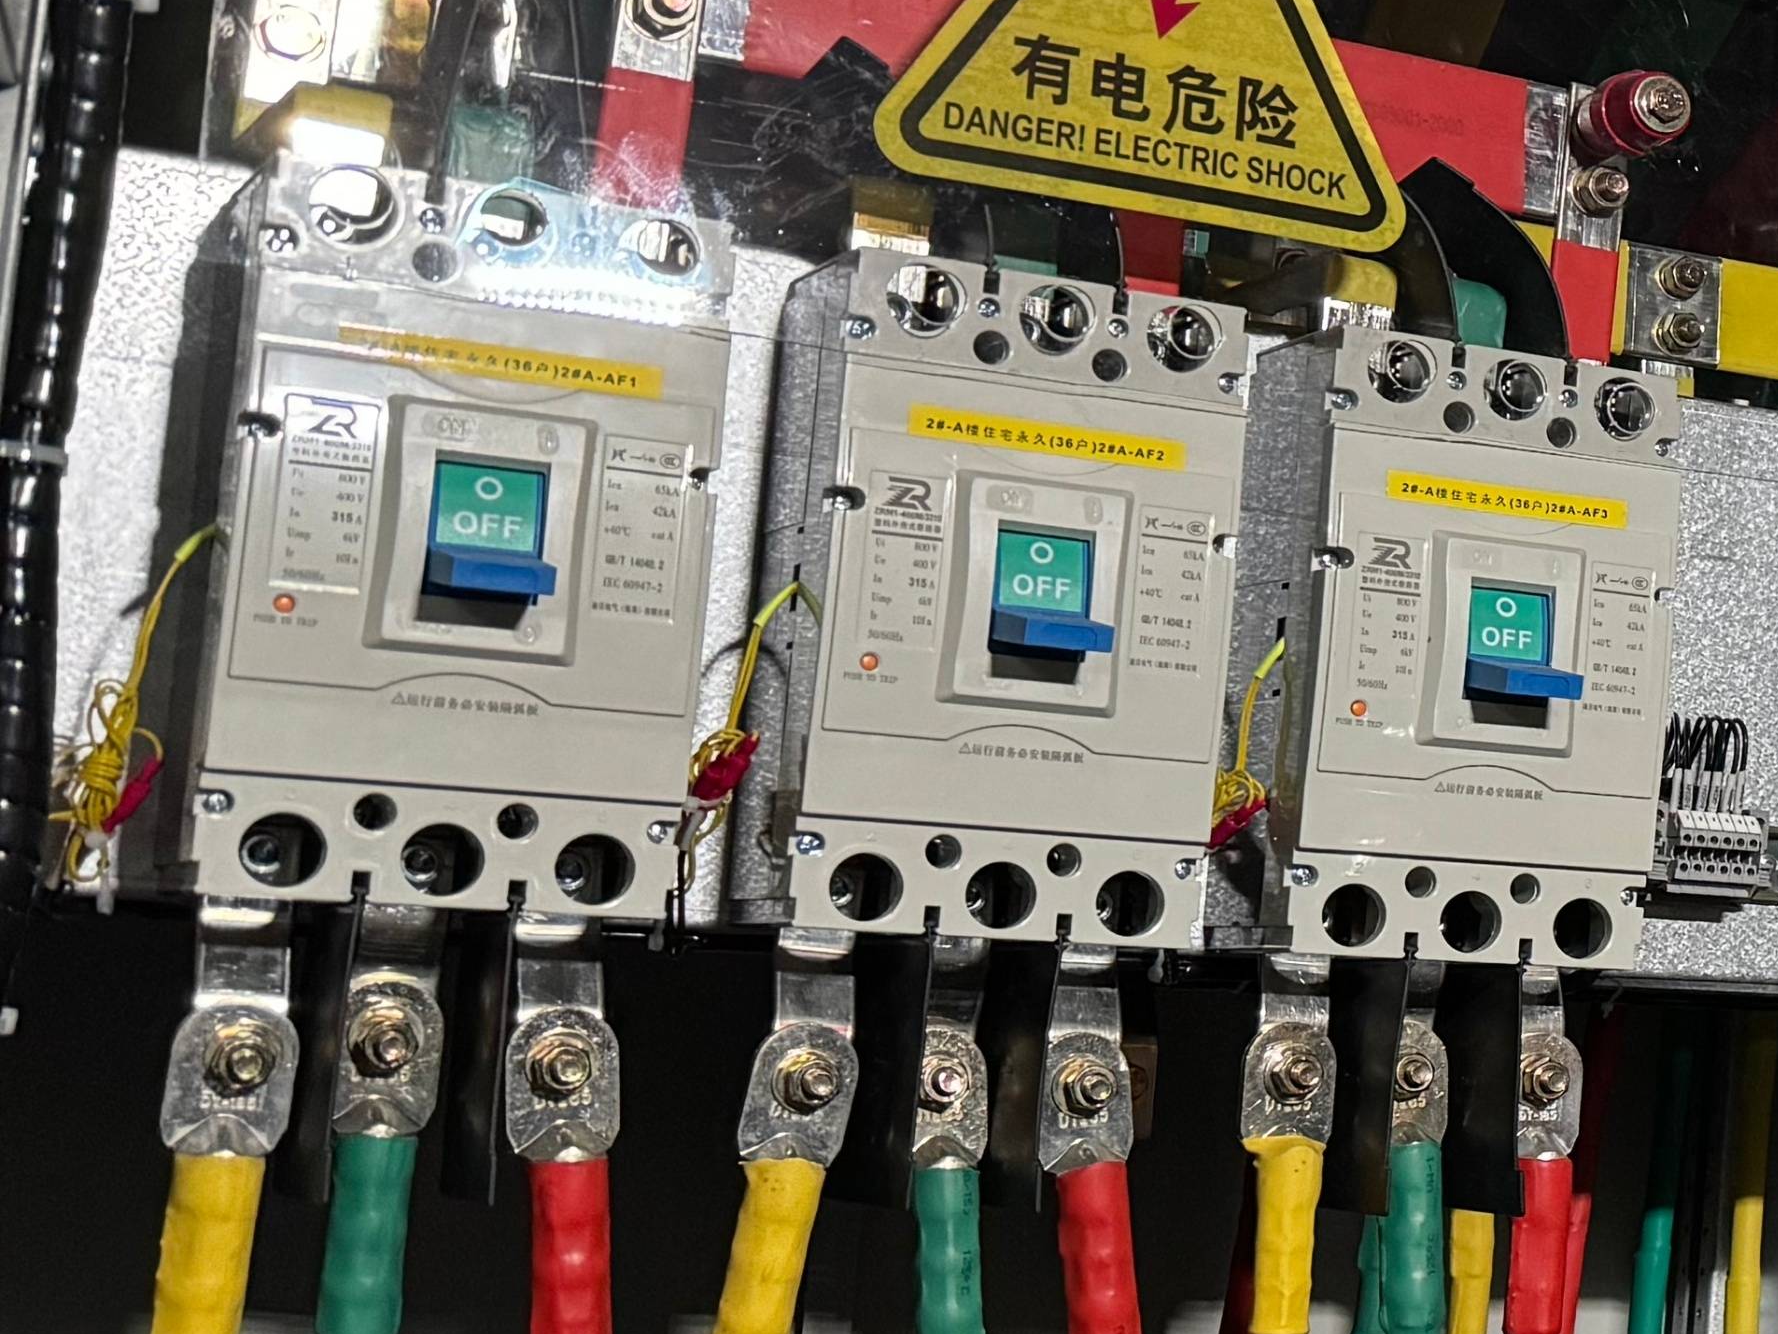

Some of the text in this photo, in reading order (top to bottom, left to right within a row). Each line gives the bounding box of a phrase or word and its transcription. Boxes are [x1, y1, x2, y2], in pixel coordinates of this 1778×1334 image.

[1011, 34, 1299, 150] 有电危险
[943, 101, 1348, 201] DANGER! ELECTRIC SHOCK
[332, 511, 354, 524] 315
[452, 510, 523, 539] OFF
[908, 577, 927, 589] 315
[1012, 574, 1071, 599] OFF
[1392, 630, 1408, 640] 315
[1481, 626, 1533, 651] OFF
